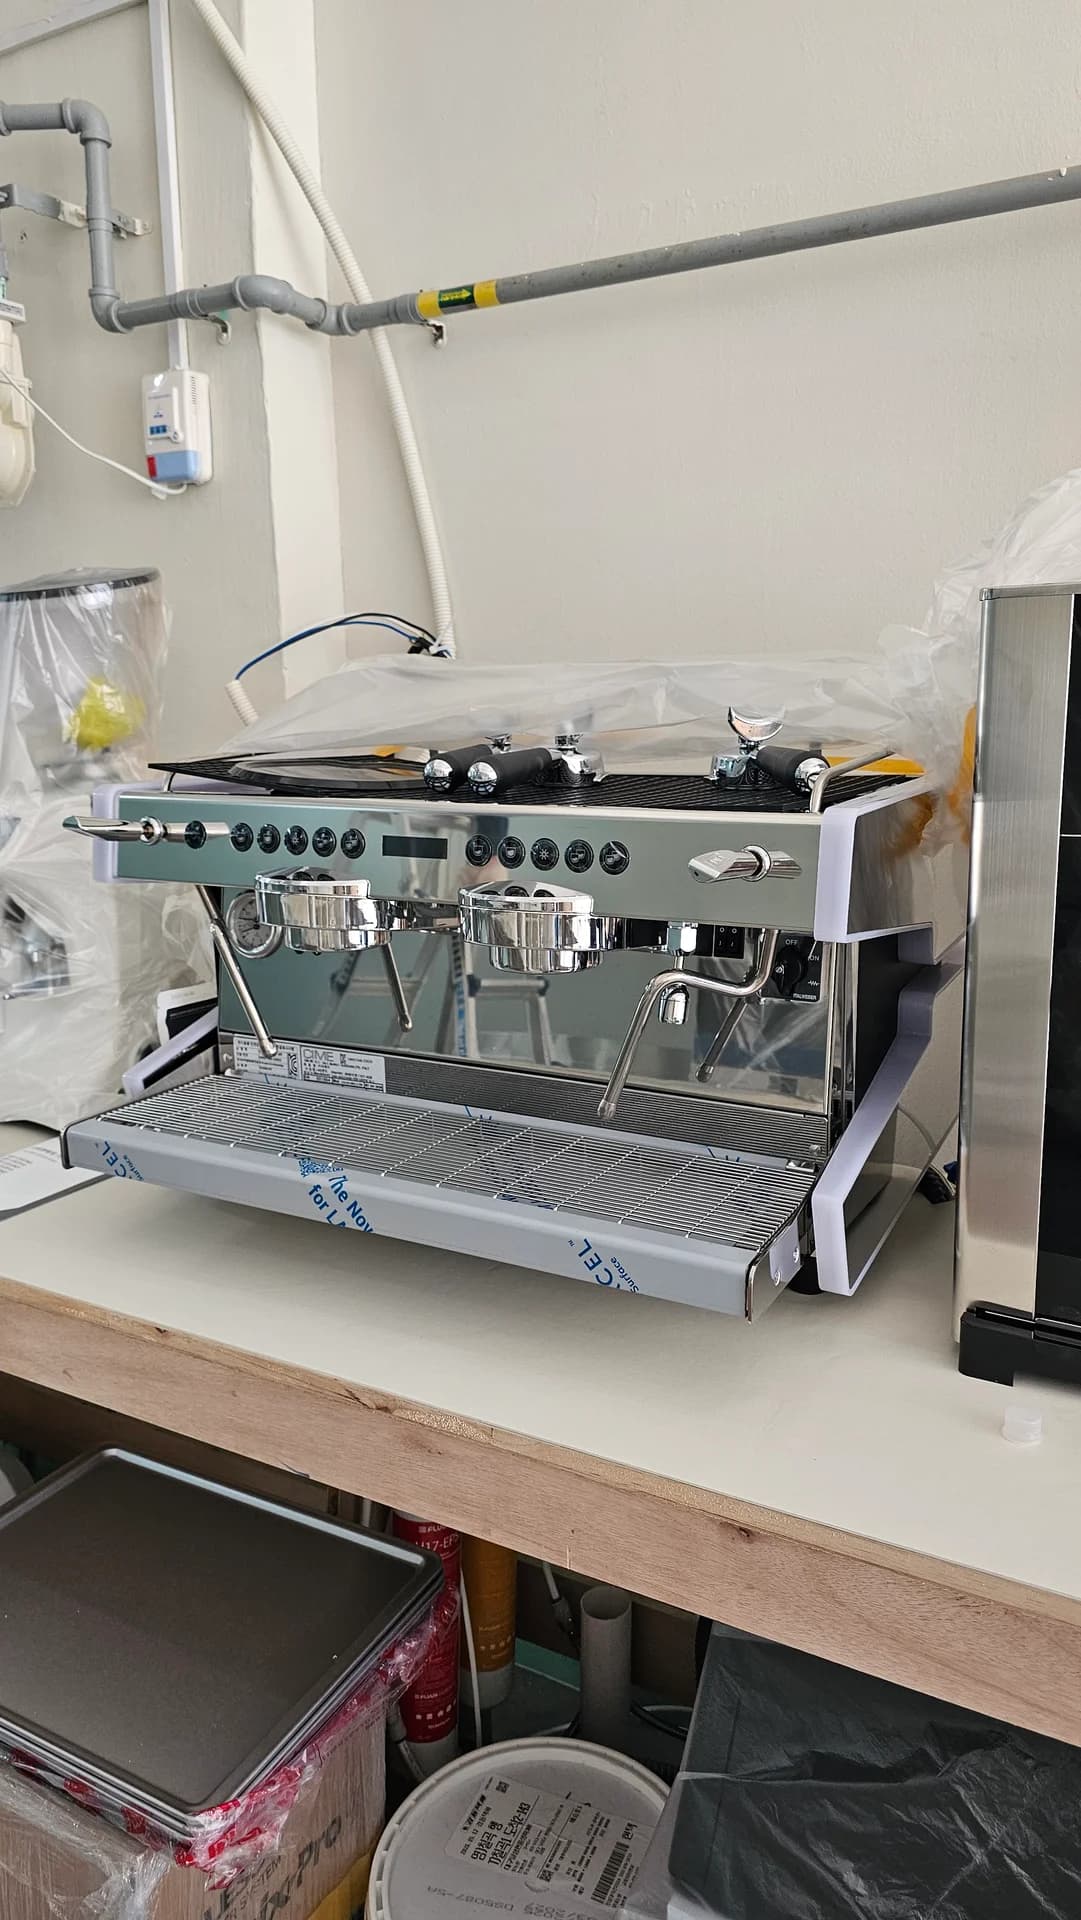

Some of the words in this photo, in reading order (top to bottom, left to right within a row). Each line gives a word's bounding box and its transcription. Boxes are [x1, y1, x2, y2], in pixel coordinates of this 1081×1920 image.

[785, 938, 798, 946] OFF
[102, 1140, 132, 1179] CEL
[308, 1184, 330, 1211] for
[328, 1174, 349, 1203] The
[577, 1237, 621, 1289] CEL
